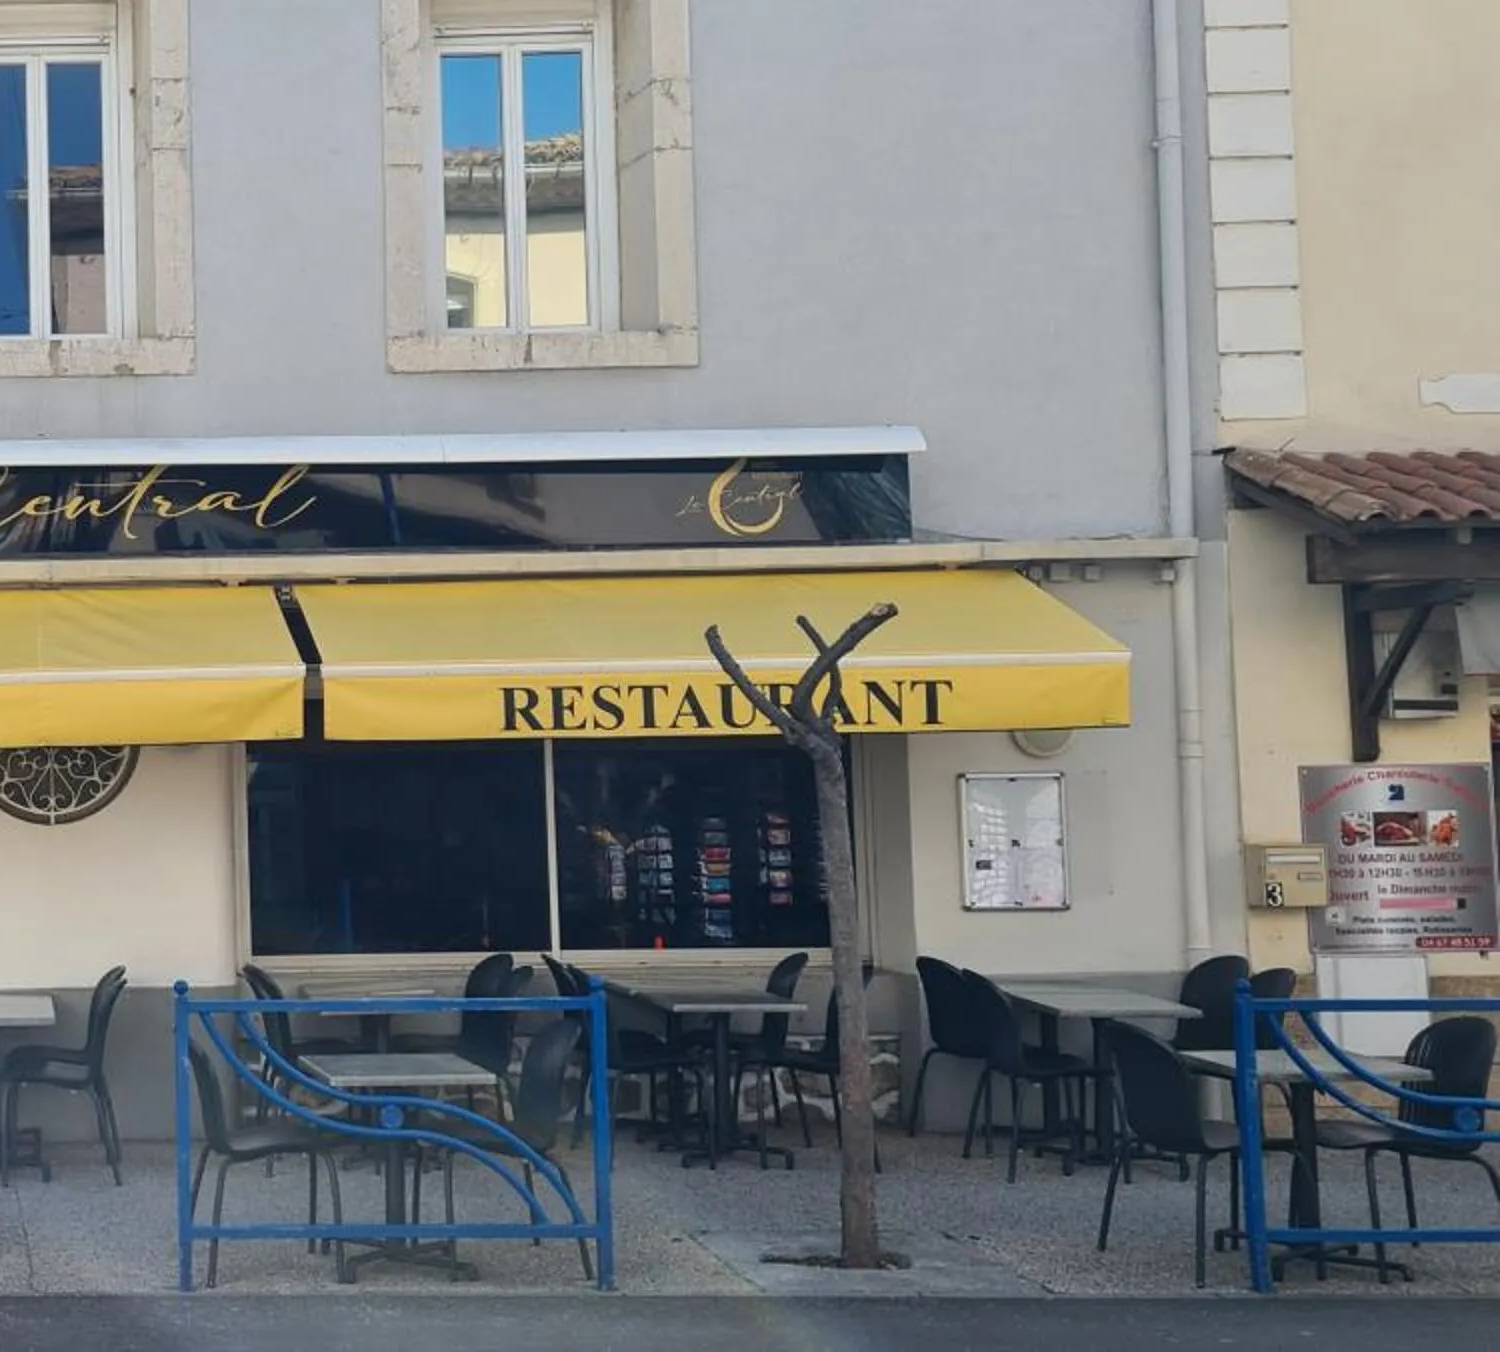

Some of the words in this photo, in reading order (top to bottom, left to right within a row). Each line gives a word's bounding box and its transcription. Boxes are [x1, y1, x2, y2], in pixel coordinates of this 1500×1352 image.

[1338, 853, 1355, 864] DU
[1358, 853, 1397, 864] MARDI
[1400, 853, 1415, 863] AU
[1419, 852, 1464, 863] SAMEDI
[1368, 866, 1402, 879] 12H30
[1267, 883, 1283, 907] 3
